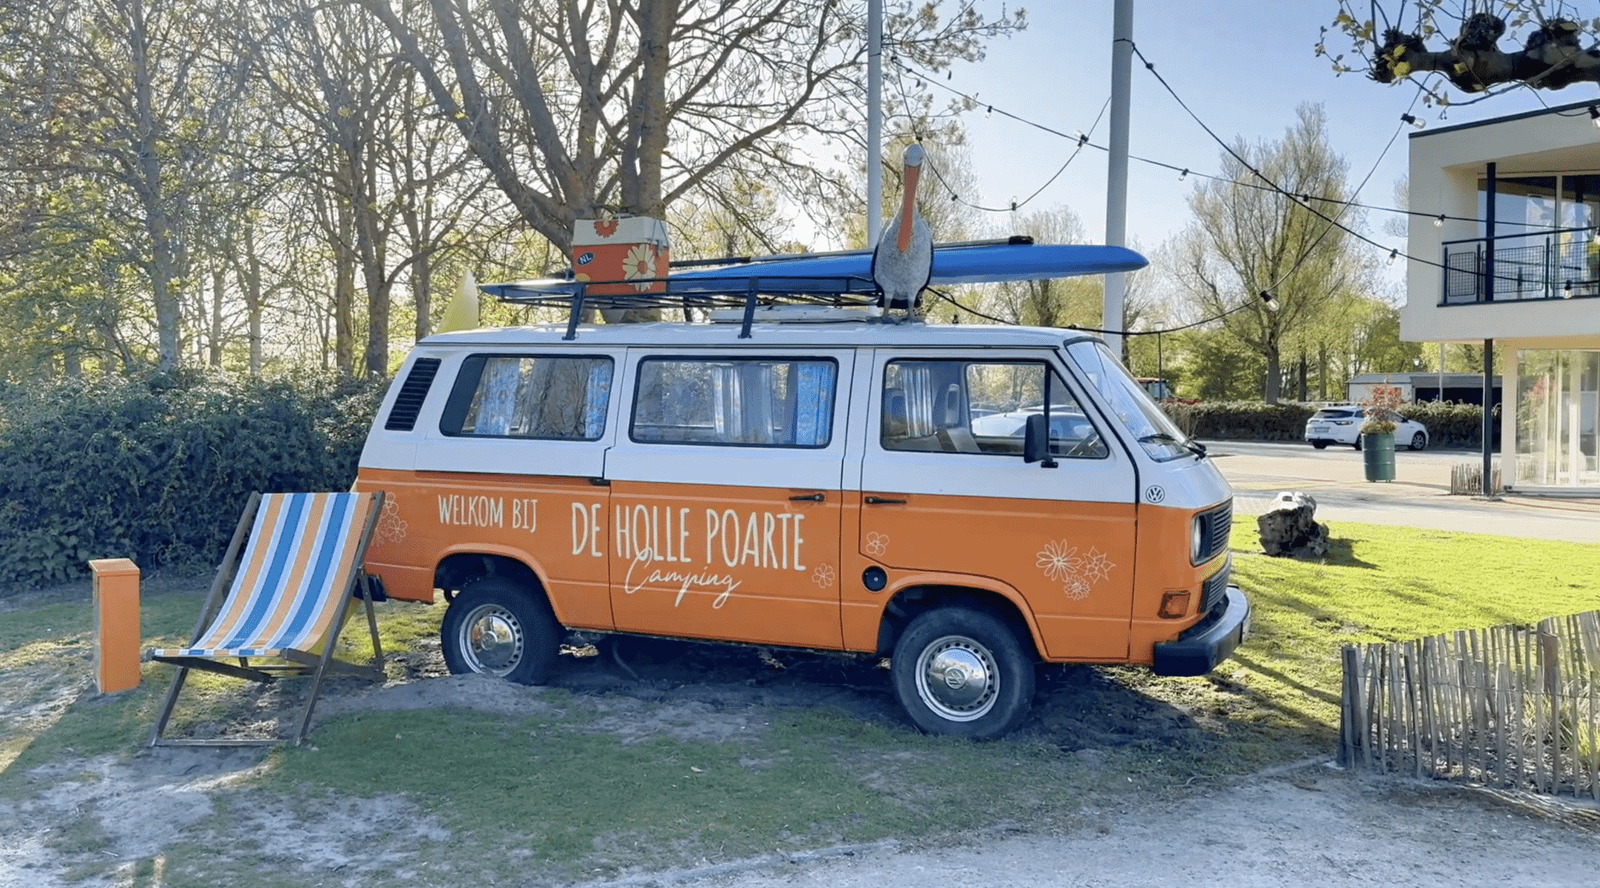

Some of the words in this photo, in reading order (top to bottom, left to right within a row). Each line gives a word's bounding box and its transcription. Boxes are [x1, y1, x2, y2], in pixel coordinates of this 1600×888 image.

[579, 253, 593, 264] NL
[437, 494, 503, 528] WELKOM
[512, 498, 538, 533] BIJ
[1145, 485, 1165, 503] VW
[571, 502, 602, 557] DE
[615, 504, 692, 562] HOLLE
[706, 508, 807, 571] POARTE
[624, 546, 742, 609] Camping
